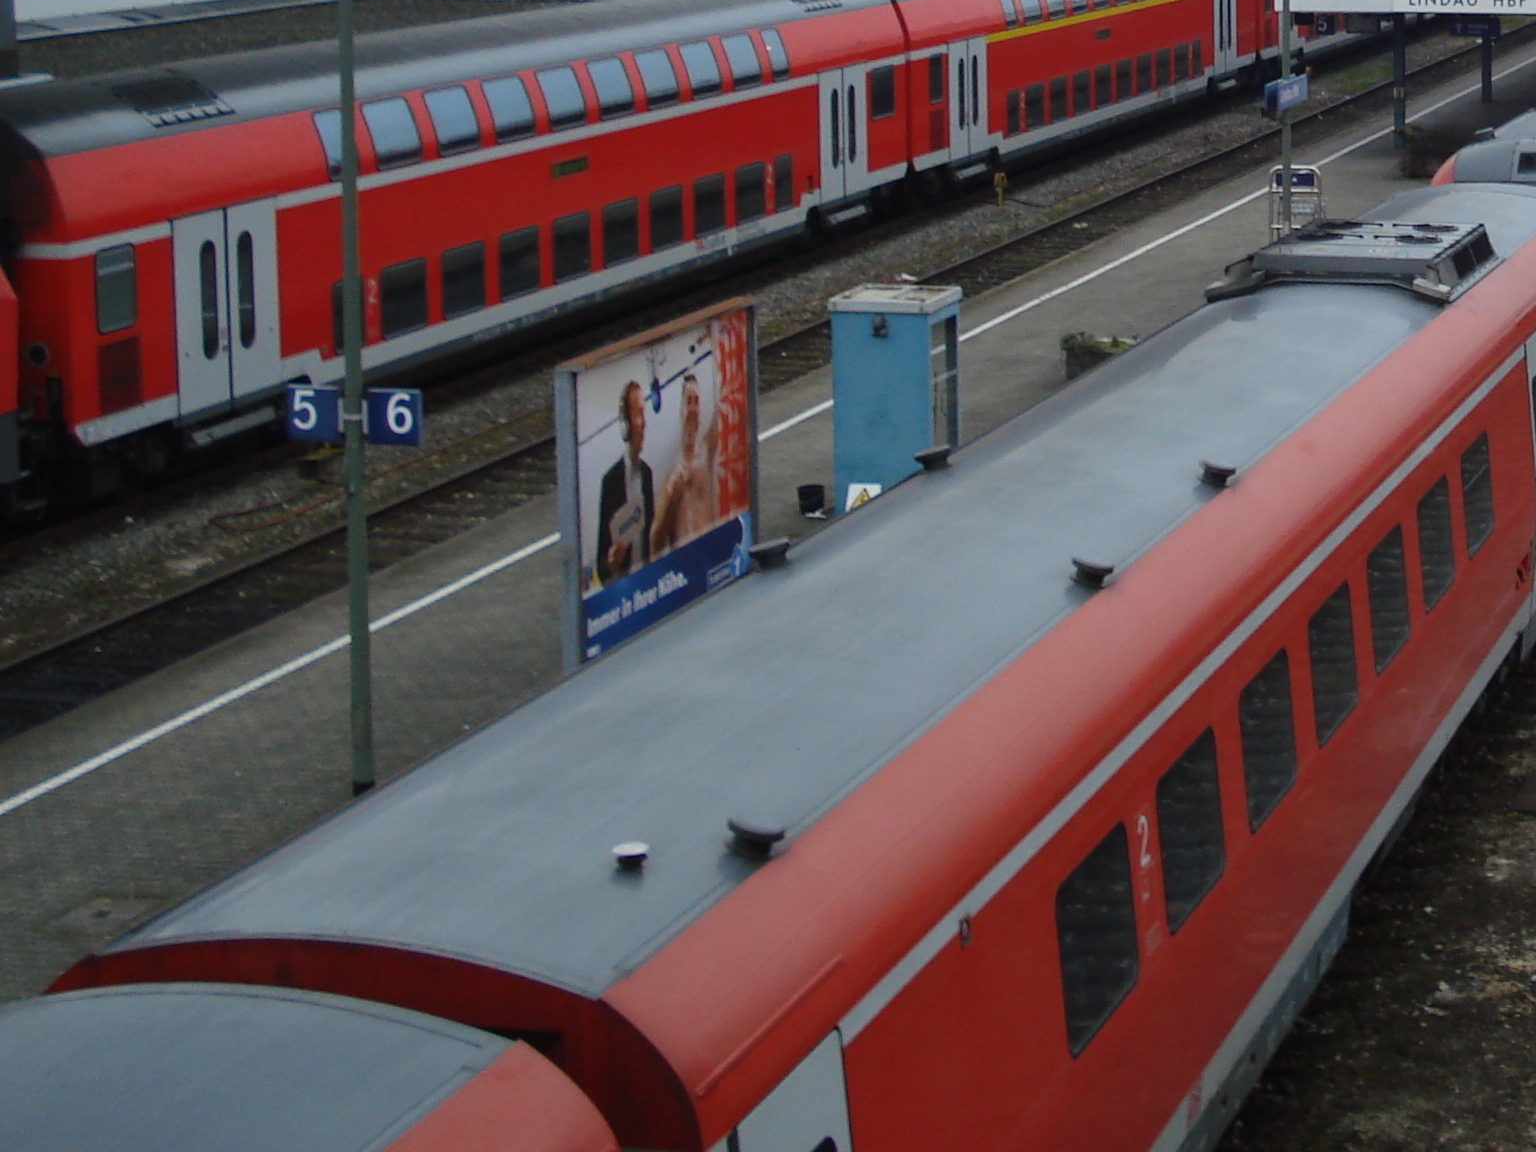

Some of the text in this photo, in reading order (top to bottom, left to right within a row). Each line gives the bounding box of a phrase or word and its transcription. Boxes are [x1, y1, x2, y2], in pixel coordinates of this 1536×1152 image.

[1318, 15, 1327, 32] 5
[293, 389, 318, 430] 5
[386, 393, 414, 435] 6
[1137, 814, 1152, 868] 2
